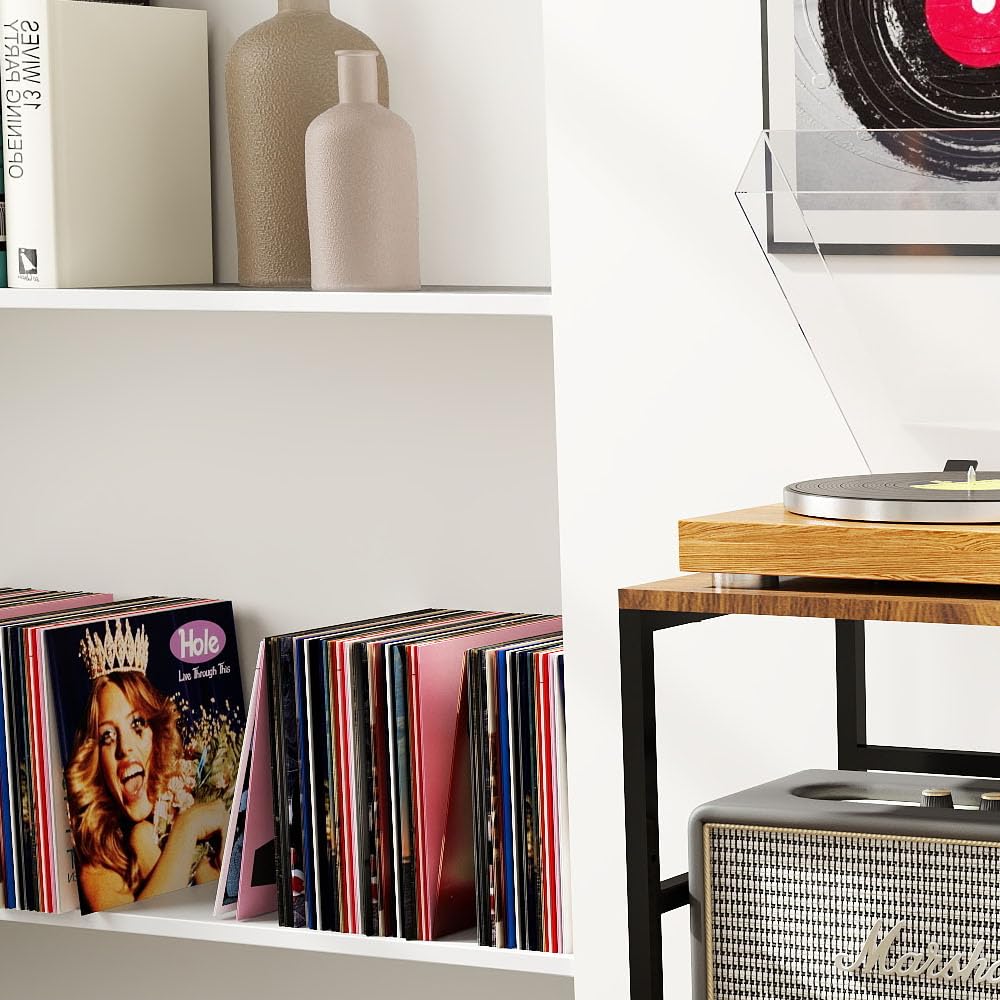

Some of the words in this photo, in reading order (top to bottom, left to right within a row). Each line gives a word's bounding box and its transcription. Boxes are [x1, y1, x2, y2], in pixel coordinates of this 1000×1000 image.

[178, 628, 219, 659] Hole
[178, 669, 192, 682] Live
[192, 666, 217, 679] Through
[217, 661, 231, 675] This
